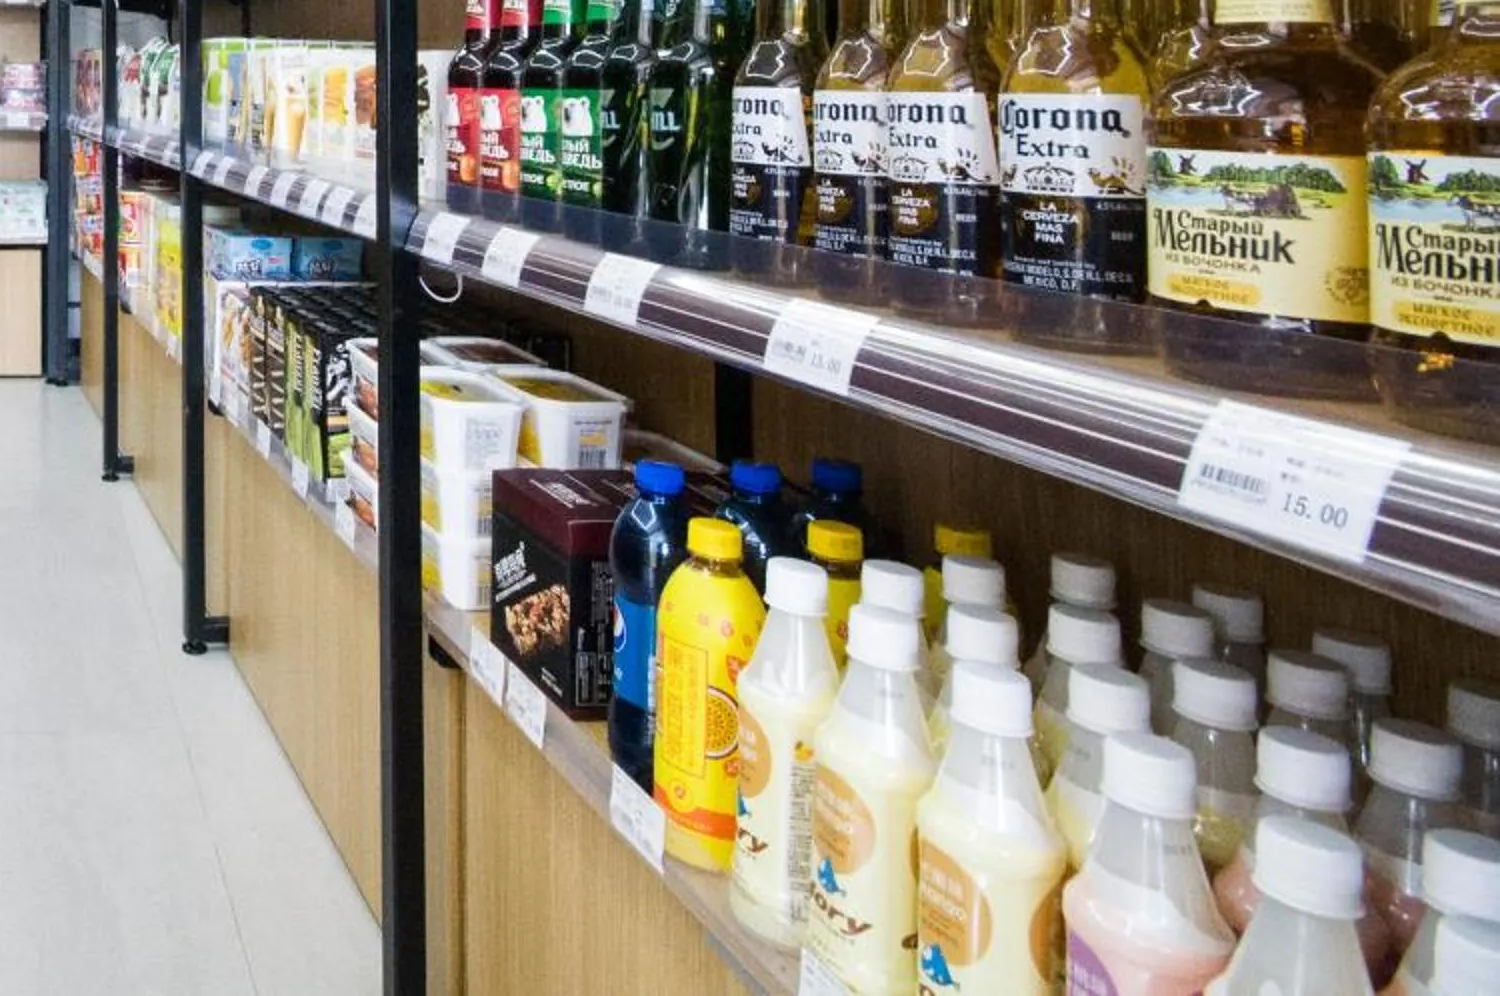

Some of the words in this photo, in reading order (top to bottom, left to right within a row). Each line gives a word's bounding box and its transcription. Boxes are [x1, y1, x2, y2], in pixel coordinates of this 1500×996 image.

[733, 97, 784, 118] rona
[887, 102, 970, 126] orona
[1002, 98, 1131, 139] Corona
[1015, 133, 1090, 160] Extra
[1021, 209, 1080, 224] CERVEZA
[1040, 201, 1057, 212] LA
[1034, 222, 1064, 234] MAS
[1178, 209, 1264, 237] Старый
[1033, 232, 1065, 245] FINA
[1153, 207, 1296, 265] Мельник
[1405, 225, 1500, 259] Стары
[1183, 254, 1261, 275] БОЧОНКА
[1376, 223, 1500, 283] Мельн
[1413, 279, 1500, 299] БОЧОНК
[1283, 490, 1350, 529] 15.00
